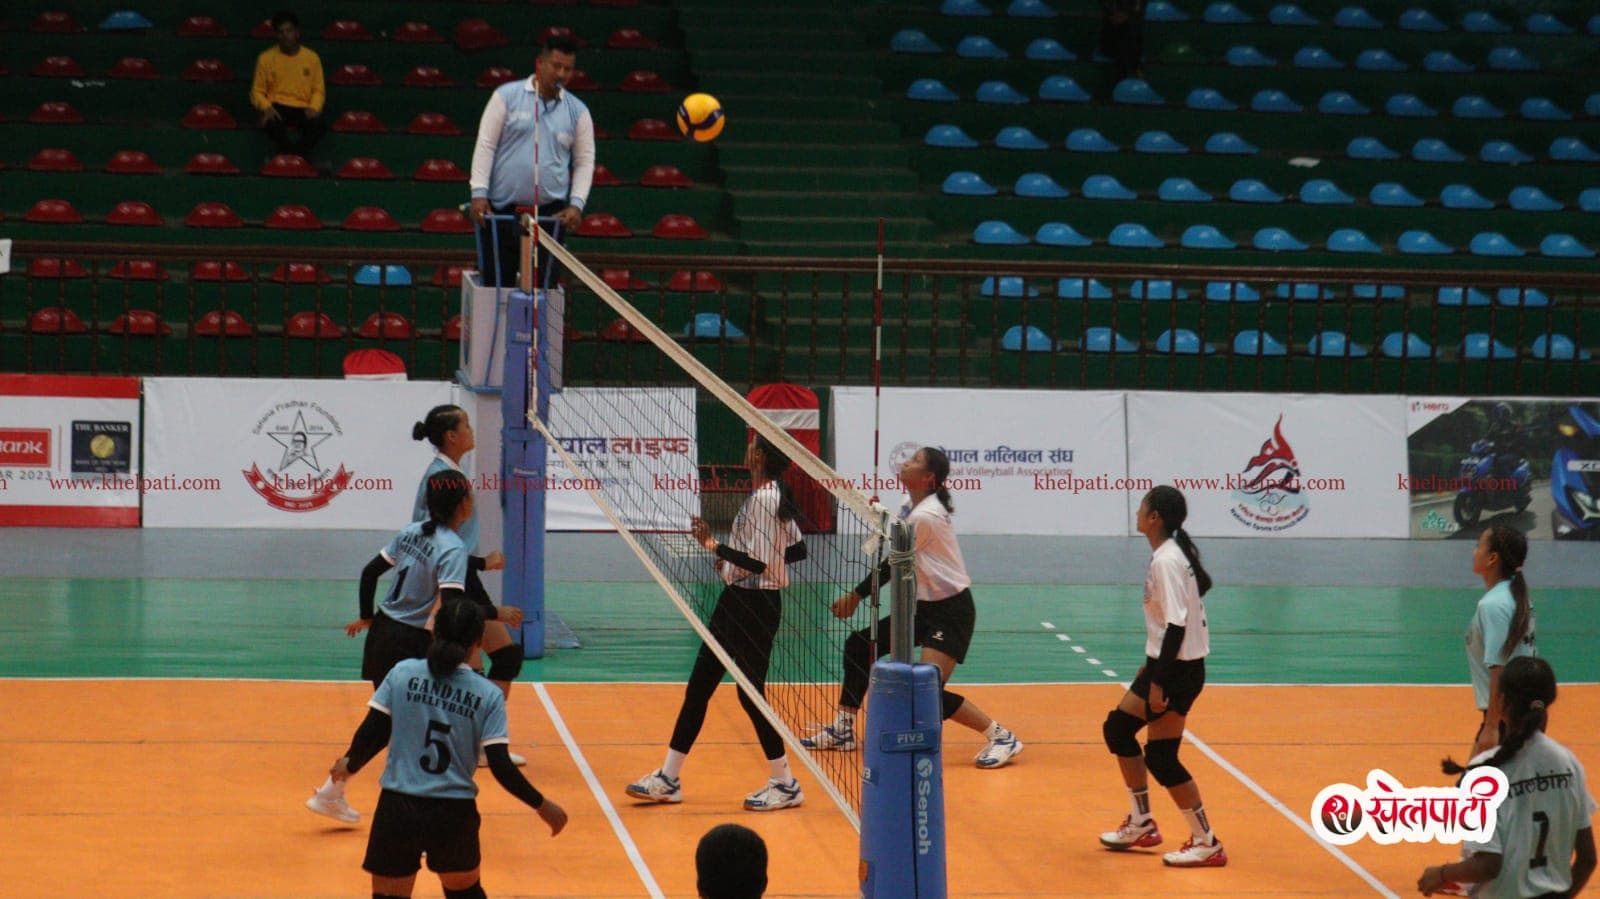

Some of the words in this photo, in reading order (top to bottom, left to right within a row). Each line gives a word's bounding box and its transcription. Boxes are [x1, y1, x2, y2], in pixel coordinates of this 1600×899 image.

[75, 423, 92, 431] THE
[93, 424, 129, 432] BANKER
[0, 440, 44, 454] ank
[965, 466, 1014, 479] Volleyball
[406, 691, 475, 719] VOLLEYBALL
[408, 676, 482, 712] GANDAKI
[420, 720, 451, 775] 5
[918, 780, 932, 855] Senoh
